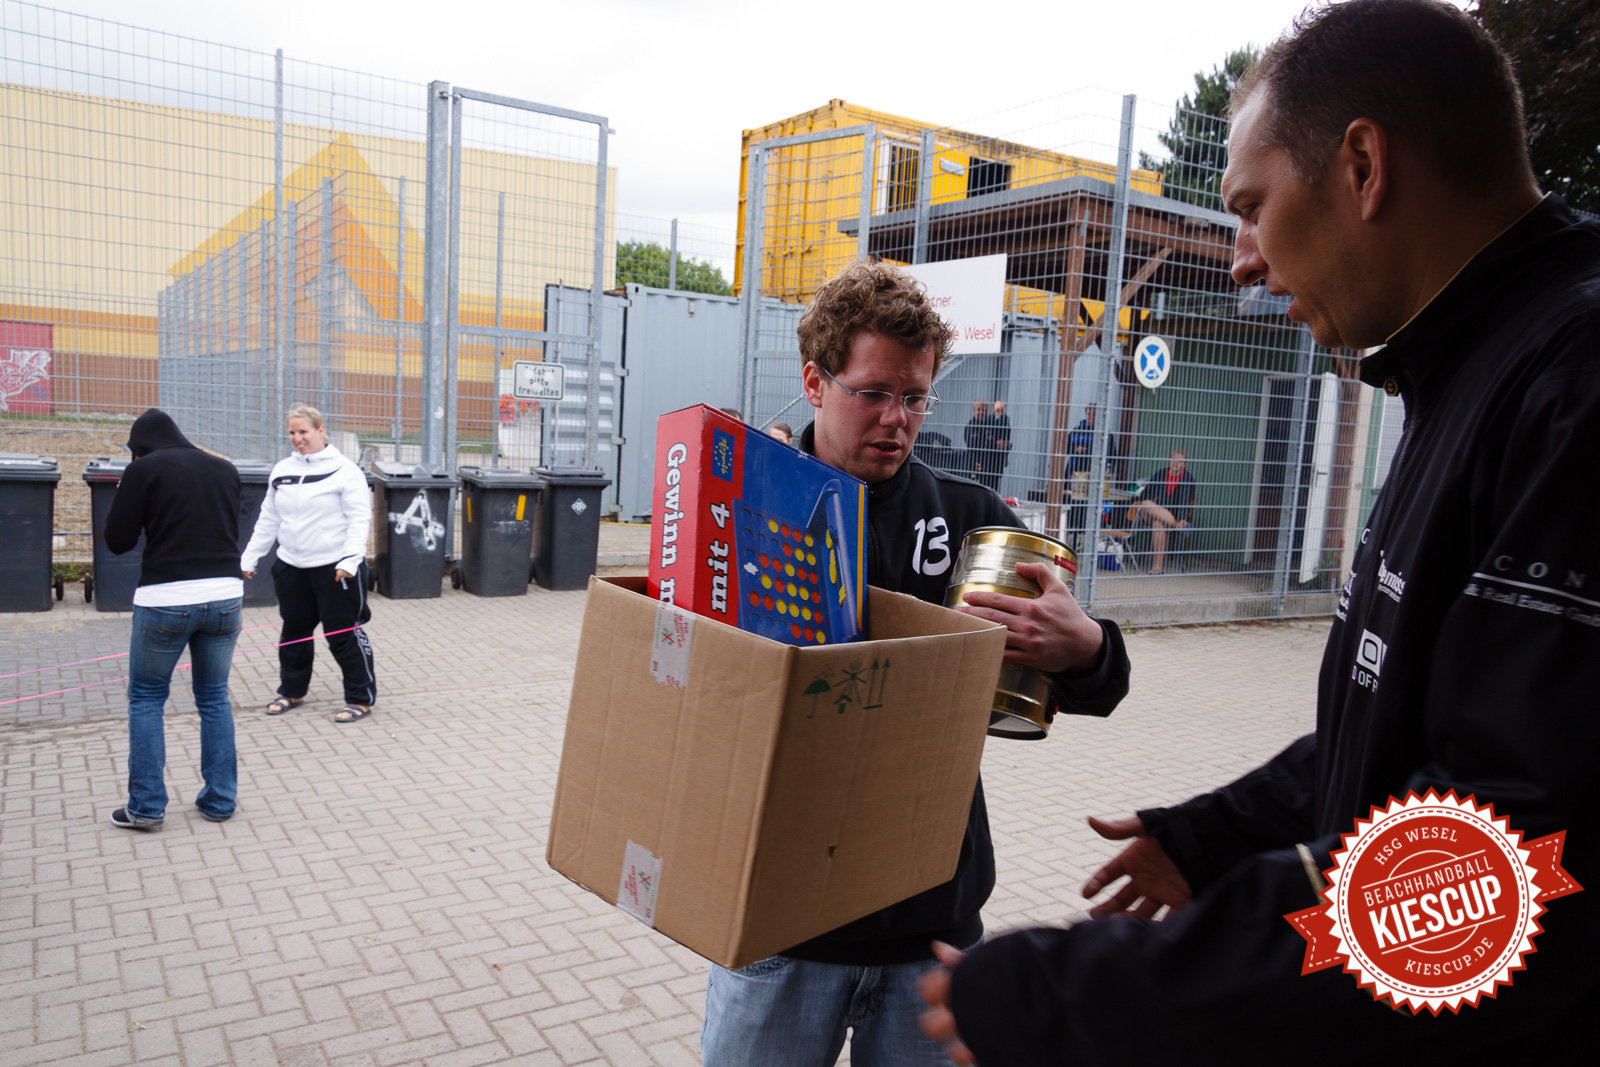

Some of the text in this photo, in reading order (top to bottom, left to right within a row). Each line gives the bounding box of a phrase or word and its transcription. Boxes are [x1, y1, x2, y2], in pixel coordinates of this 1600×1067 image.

[930, 296, 952, 308] tner
[964, 322, 996, 341] Wesel
[661, 442, 688, 569] Gewinn
[707, 501, 731, 614] mit 4
[912, 516, 951, 576] 13
